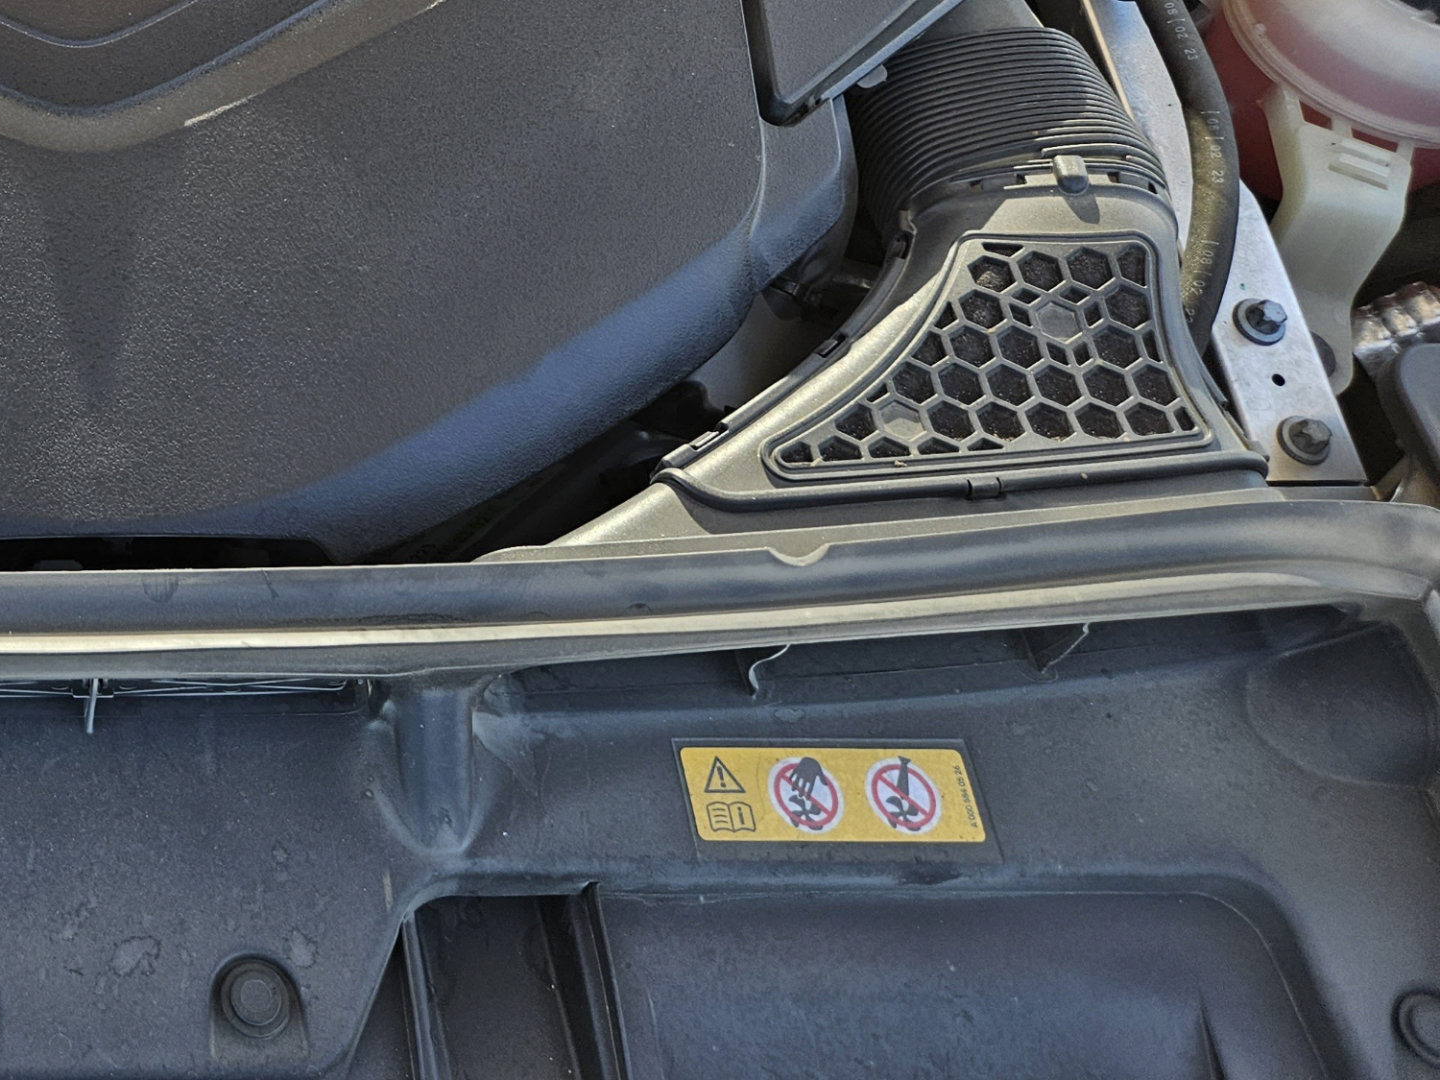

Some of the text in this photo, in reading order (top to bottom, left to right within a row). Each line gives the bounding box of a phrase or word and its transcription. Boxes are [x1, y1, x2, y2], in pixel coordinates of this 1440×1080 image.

[1175, 26, 1188, 40] 02
[1184, 48, 1199, 60] 23
[1209, 145, 1222, 158] 02
[1211, 170, 1224, 183] 23
[1200, 250, 1214, 264] 08
[953, 765, 962, 776] 26
[966, 804, 976, 821] 000
